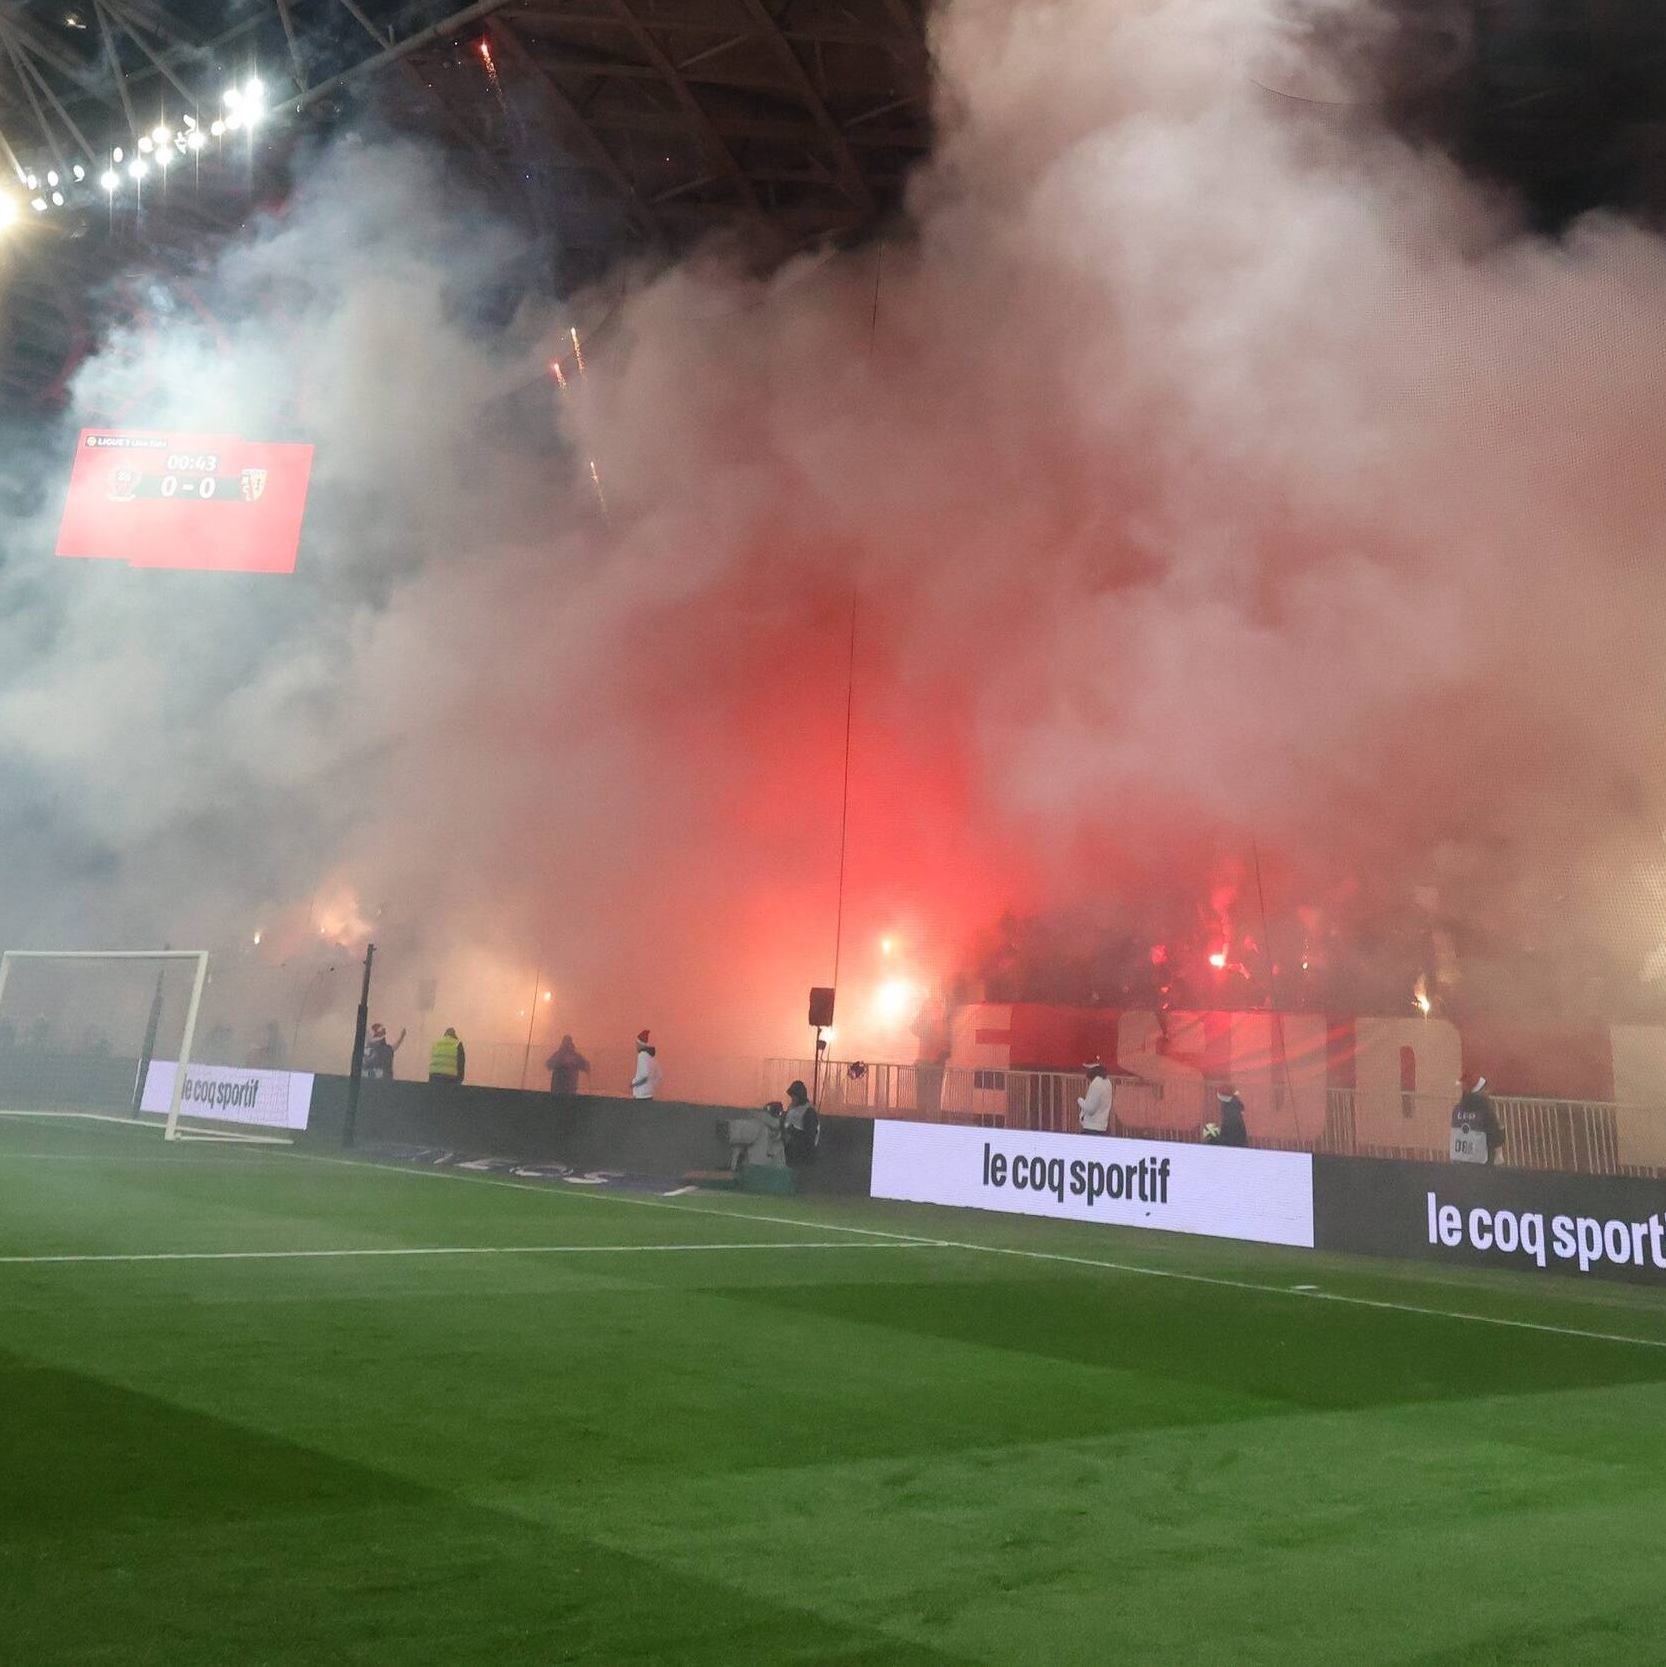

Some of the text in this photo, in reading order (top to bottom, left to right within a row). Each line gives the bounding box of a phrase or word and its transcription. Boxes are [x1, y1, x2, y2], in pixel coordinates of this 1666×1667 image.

[167, 454, 217, 471] 00:43
[161, 474, 177, 497] 0
[198, 476, 216, 499] 0
[194, 1079, 216, 1110] coq
[217, 1078, 260, 1111] sportif
[983, 1142, 1171, 1207] le coq sportif
[1427, 1191, 1464, 1247] le
[1468, 1207, 1547, 1268] coq
